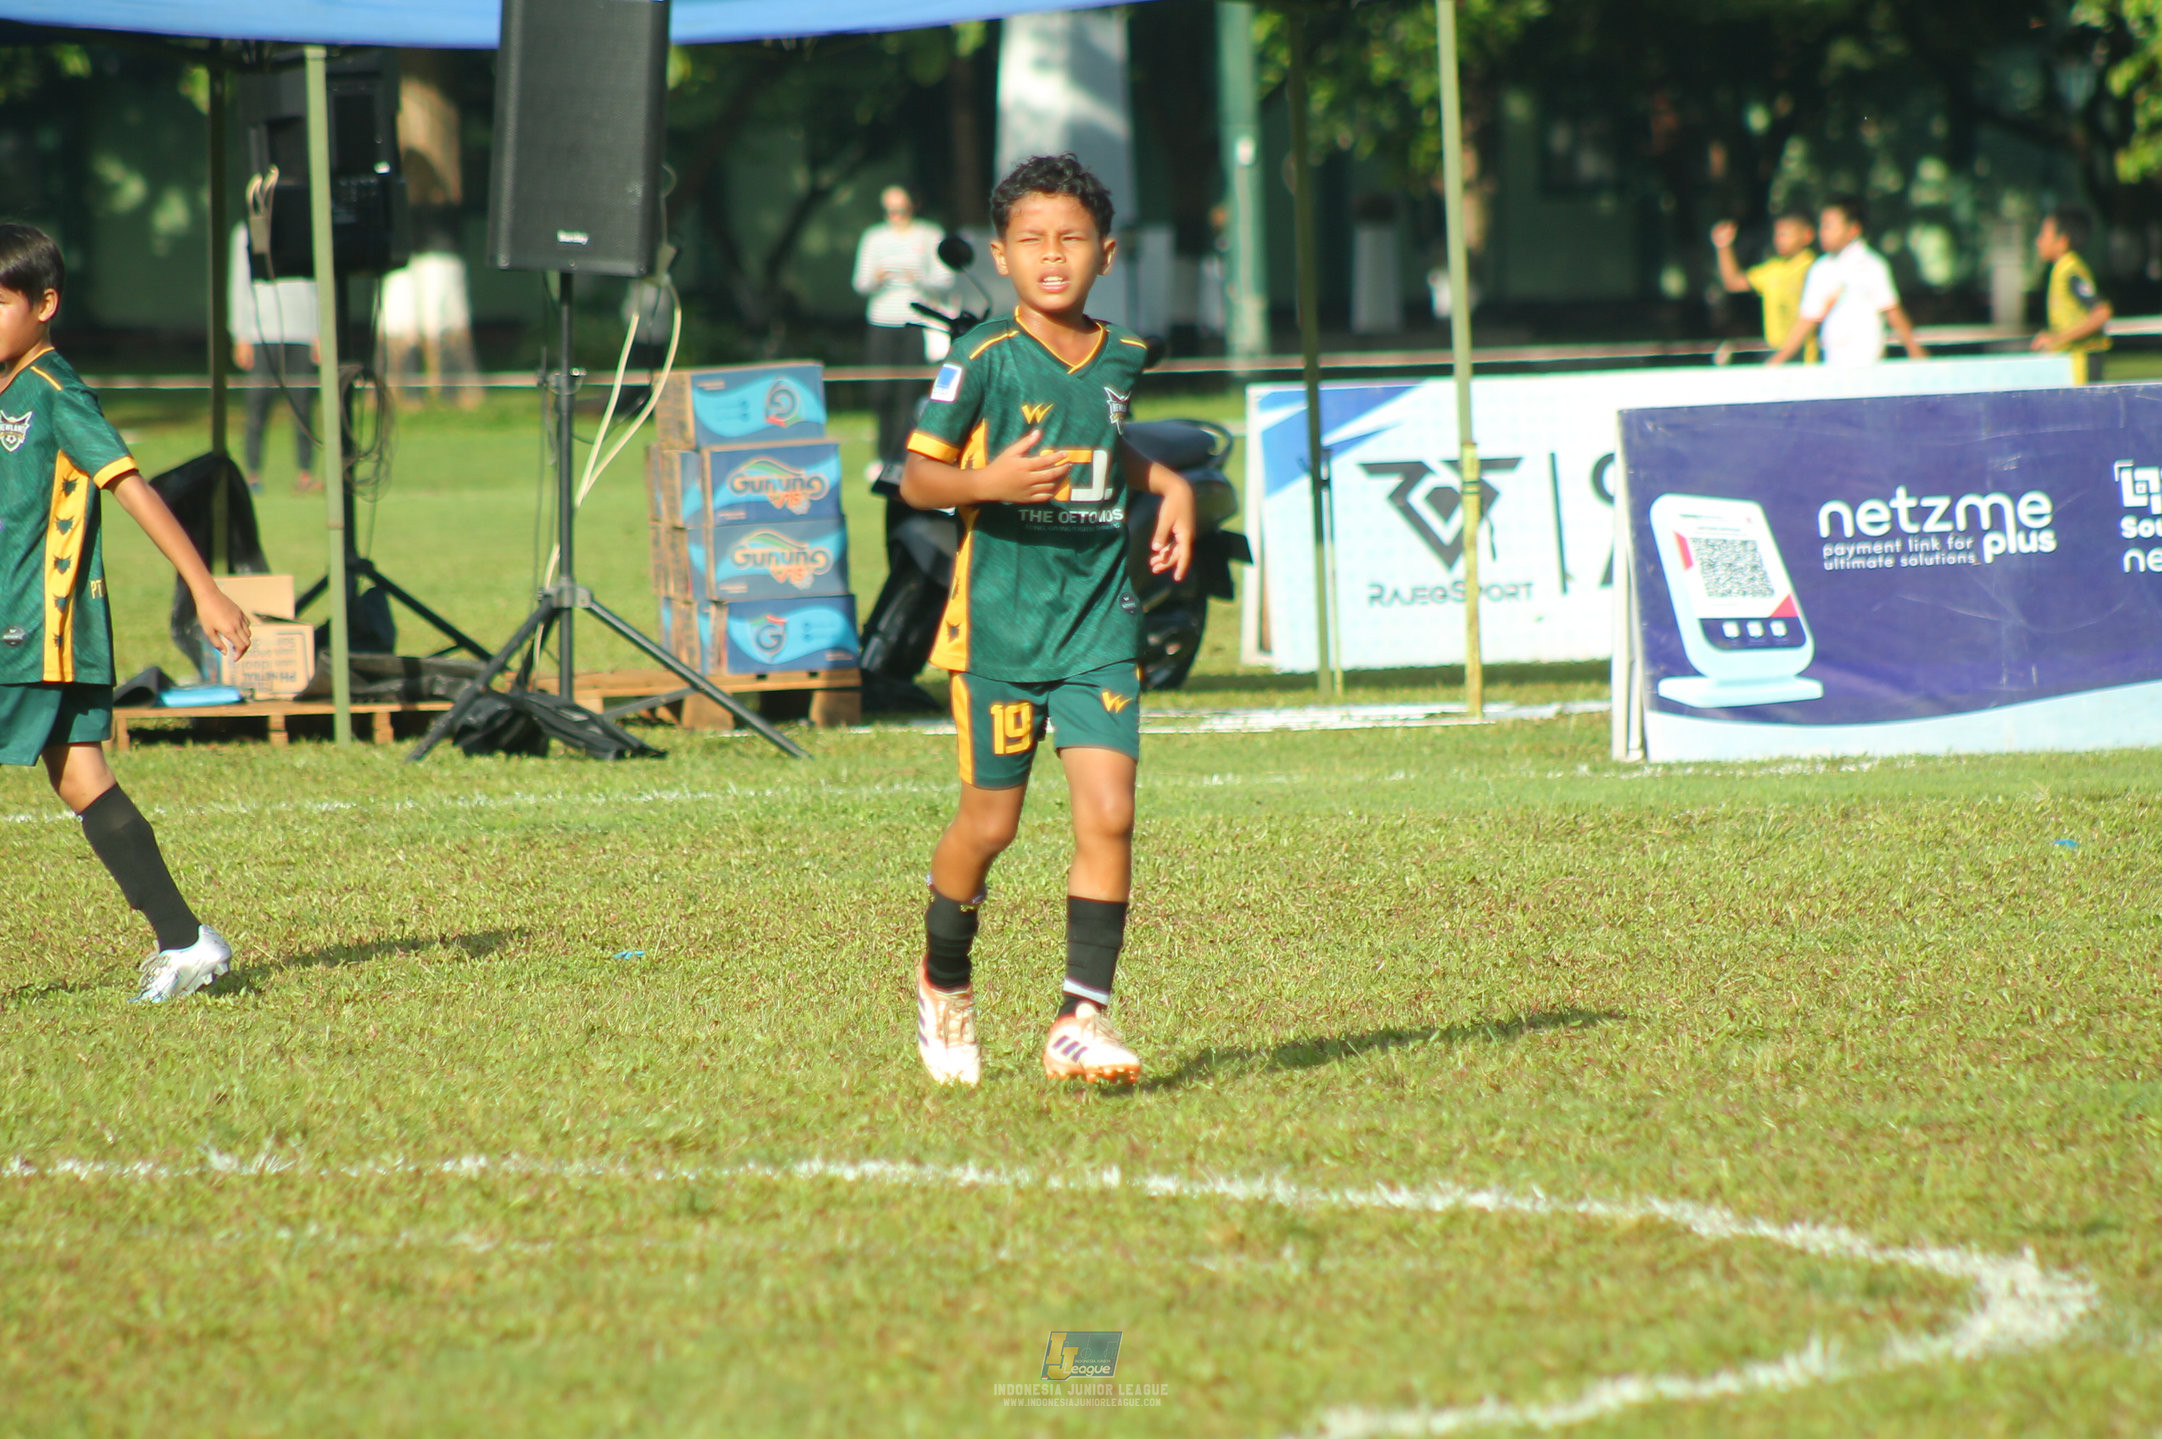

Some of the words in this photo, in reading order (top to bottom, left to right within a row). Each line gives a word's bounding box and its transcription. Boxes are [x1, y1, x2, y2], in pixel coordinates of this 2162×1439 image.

[1018, 508, 1054, 523] THE
[1818, 485, 2053, 538] netzme
[1823, 538, 1902, 559] payment
[1908, 535, 1940, 553] link
[1947, 534, 1974, 551] for
[1823, 553, 1895, 571] ultimate
[1900, 552, 1977, 568] solutions
[1983, 529, 2057, 564] plus
[990, 702, 1031, 755] 19
